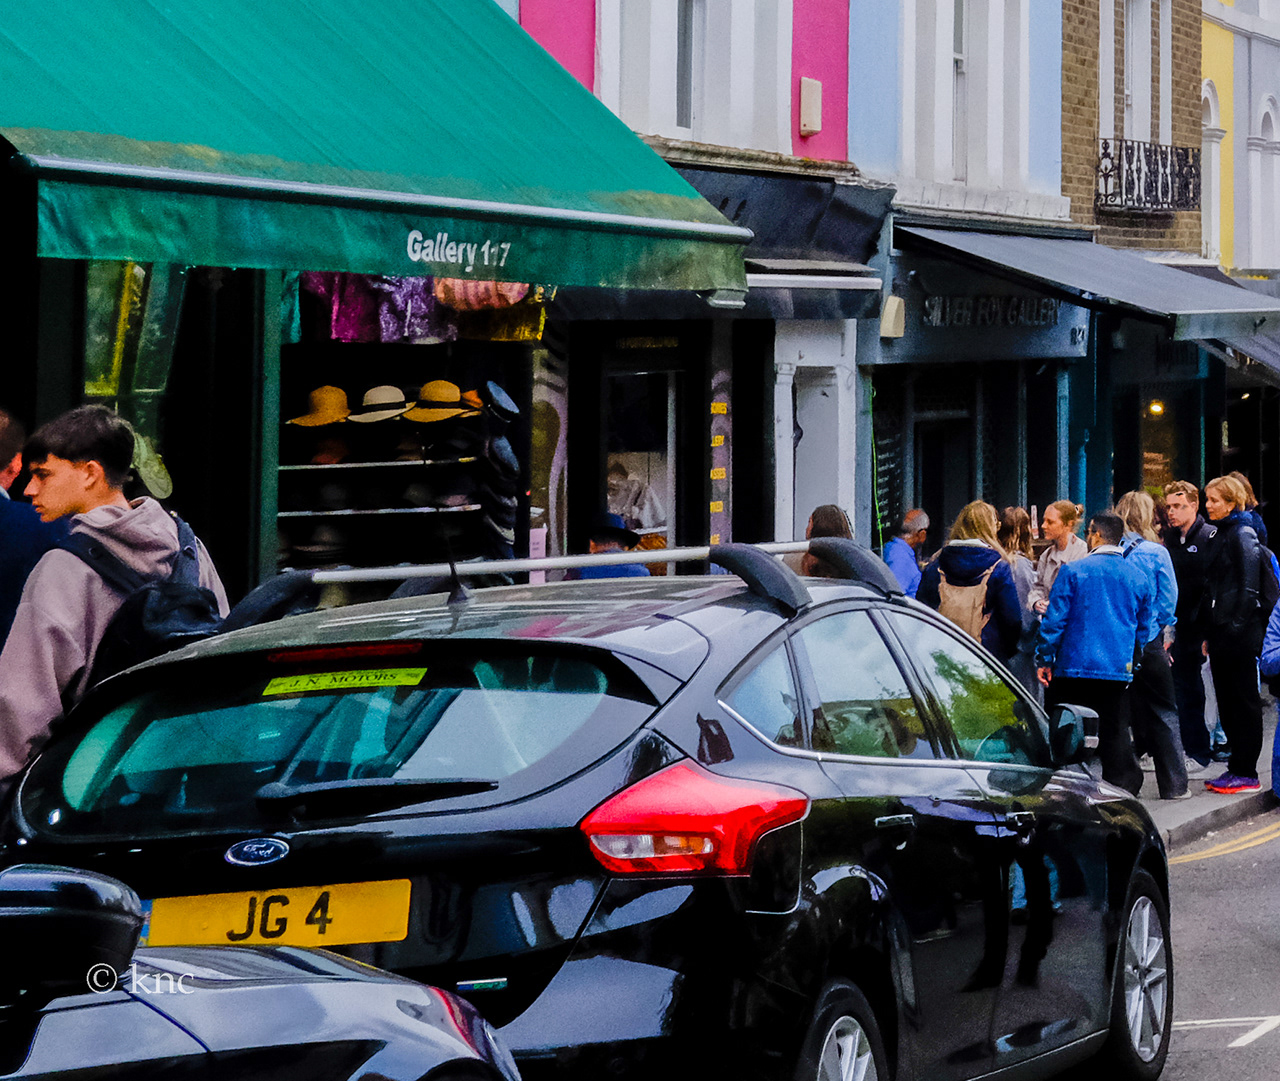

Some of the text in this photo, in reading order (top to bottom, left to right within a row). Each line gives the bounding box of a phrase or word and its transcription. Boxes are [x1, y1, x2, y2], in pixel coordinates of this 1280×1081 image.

[407, 229, 512, 273] Gallery 117
[329, 673, 398, 684] MOTORS
[226, 890, 334, 942] JG 4
